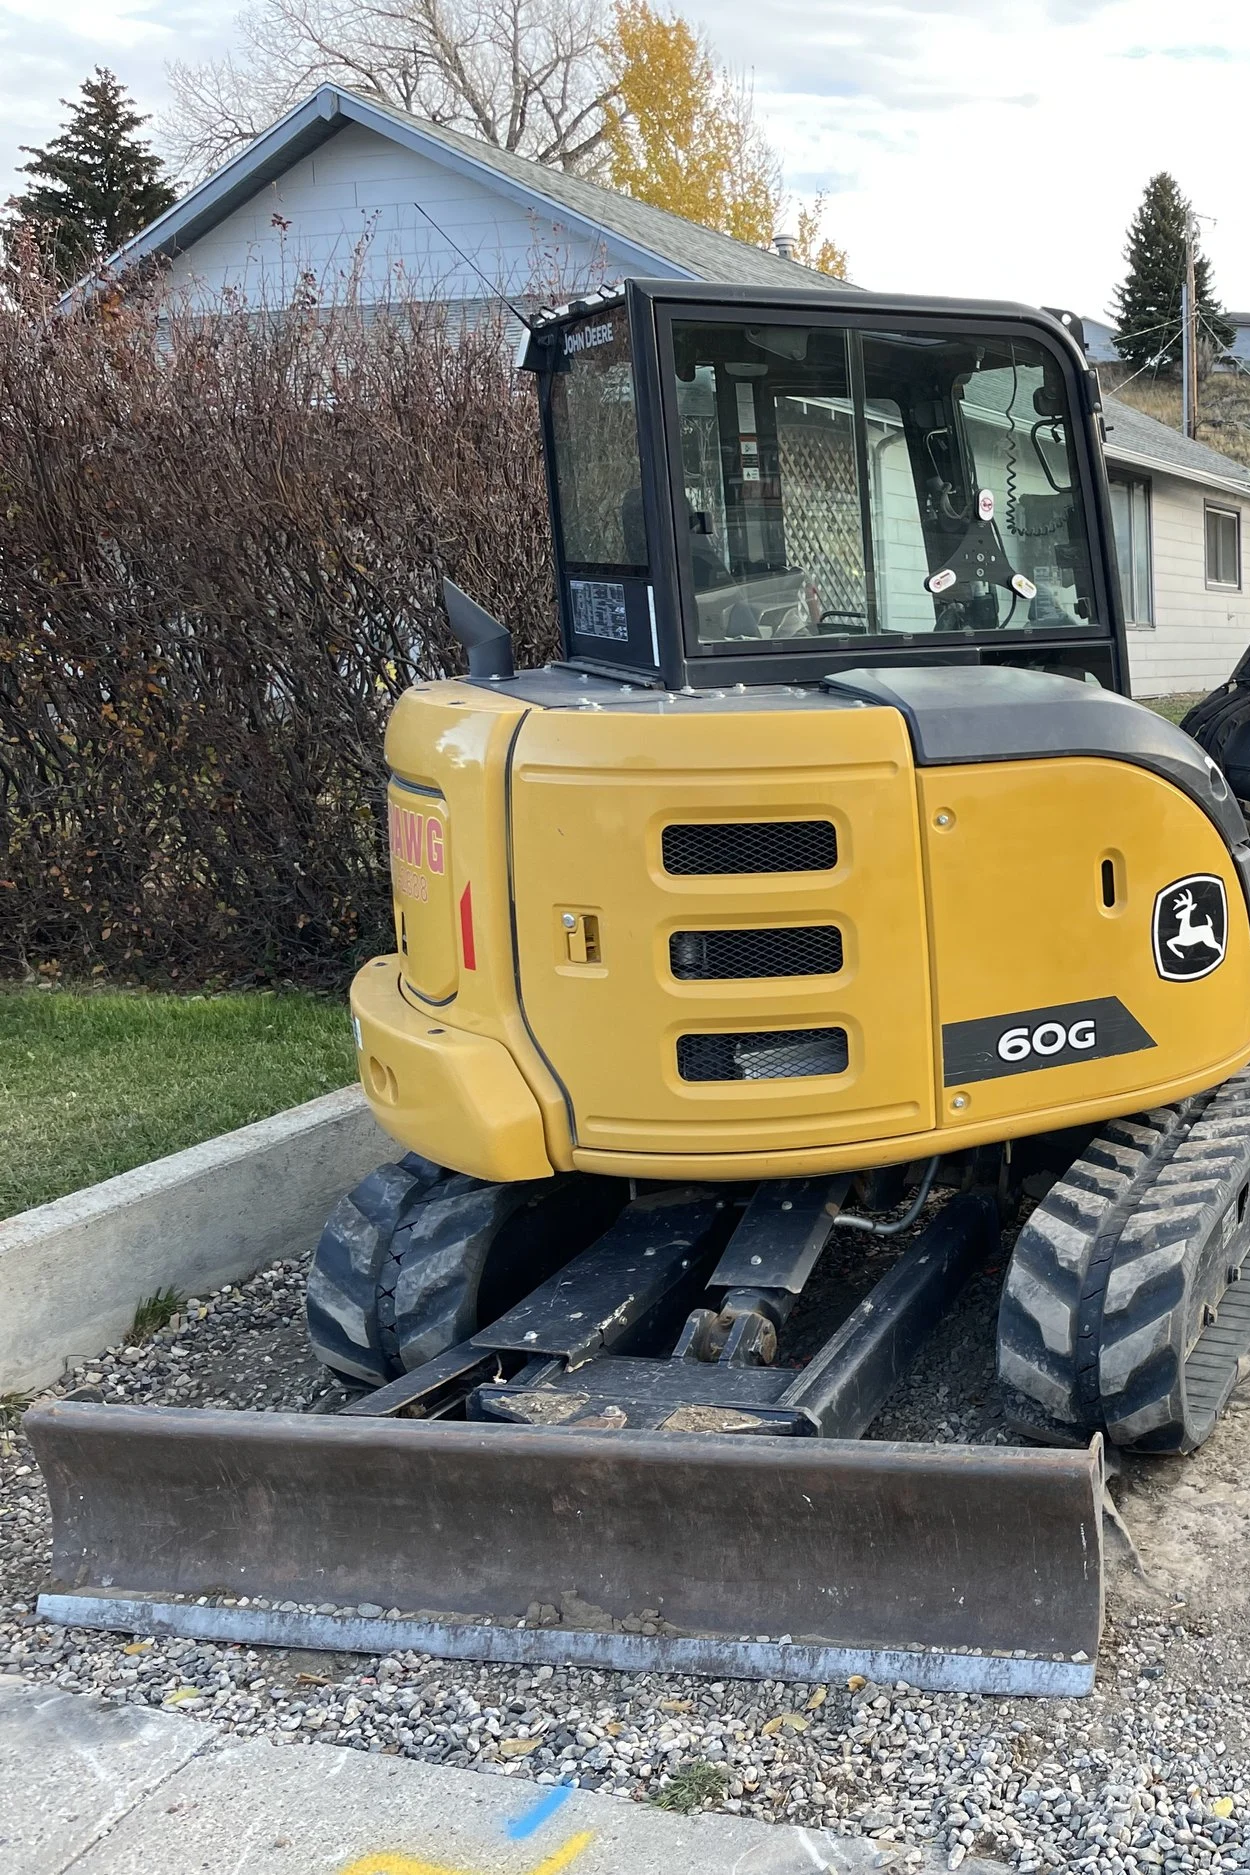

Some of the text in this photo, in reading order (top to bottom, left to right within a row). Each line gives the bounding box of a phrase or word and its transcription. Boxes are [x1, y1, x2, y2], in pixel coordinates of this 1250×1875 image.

[563, 322, 614, 355] JOHN DEERE
[997, 1019, 1097, 1062] 60G
